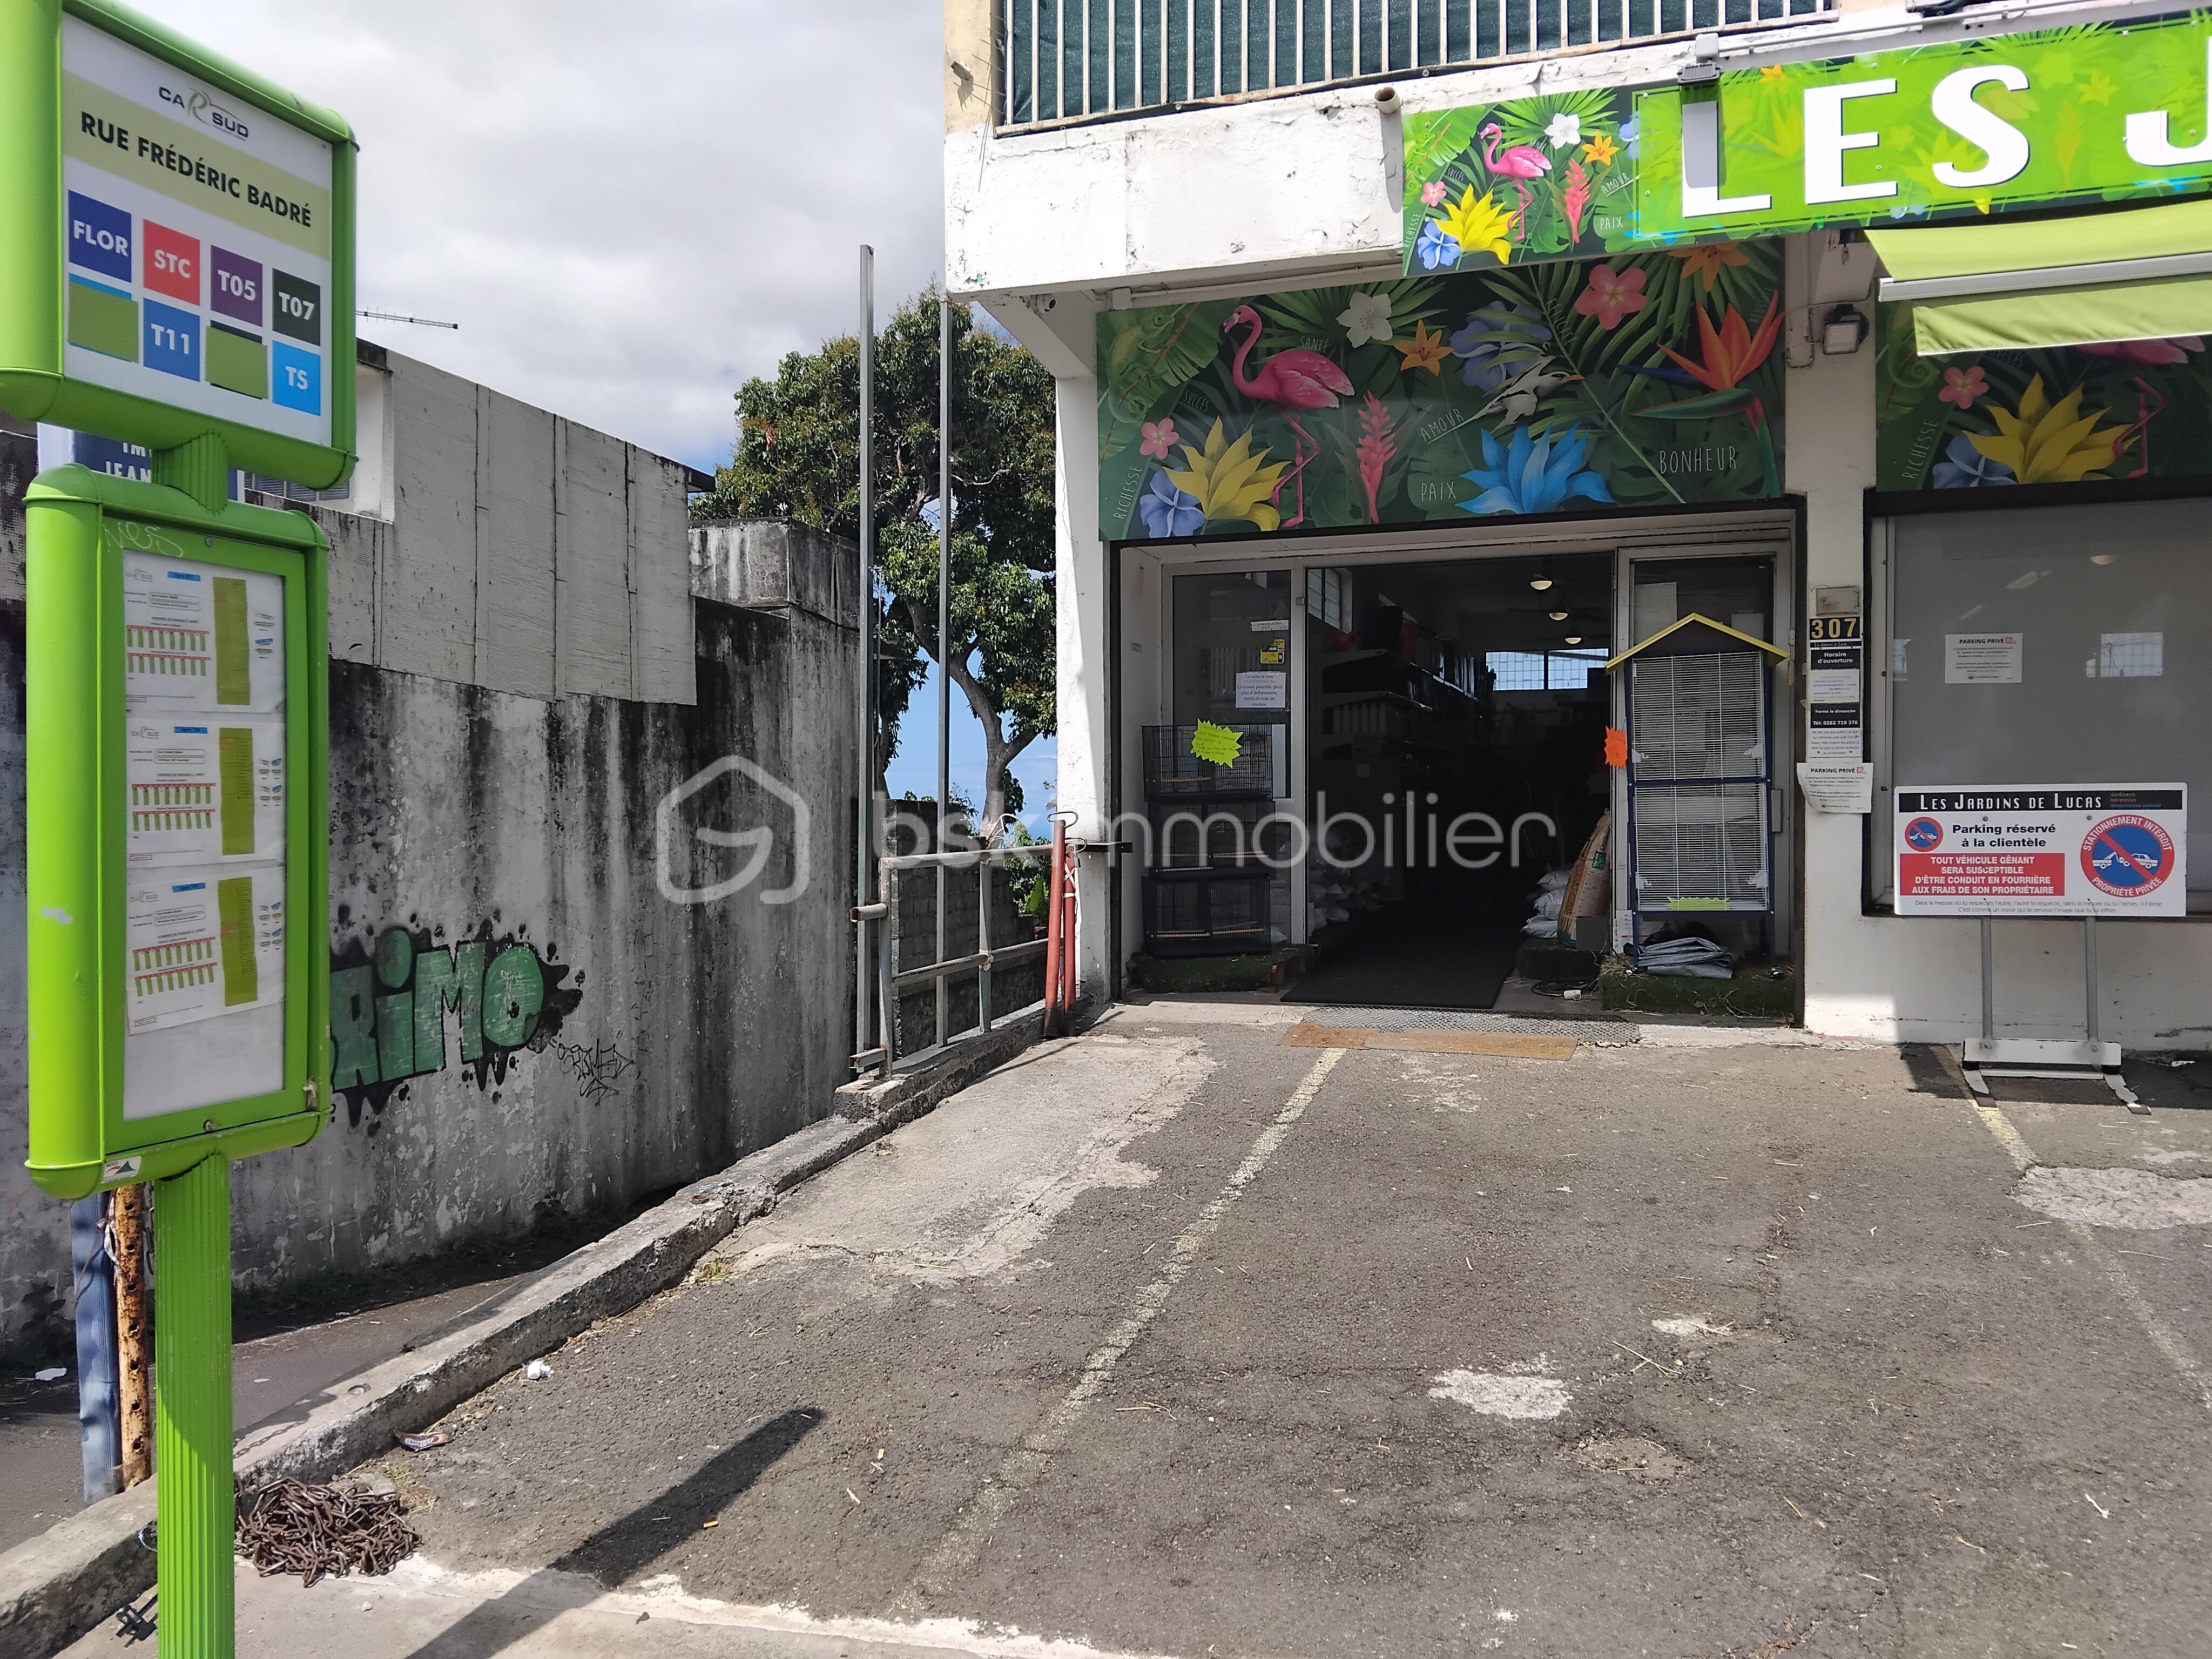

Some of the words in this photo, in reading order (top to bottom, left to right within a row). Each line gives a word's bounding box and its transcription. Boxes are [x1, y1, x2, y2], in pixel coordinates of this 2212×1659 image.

[212, 112, 249, 138] SUD
[1682, 64, 2031, 219] LES
[81, 111, 129, 151] RUE
[138, 136, 240, 198] FRÉDÉRIC
[247, 184, 311, 228] BADRÉ
[1447, 167, 1465, 182] SUCCÈS
[1602, 173, 1629, 194] AMOUR
[1403, 213, 1421, 248] RICHESSE
[1600, 216, 1623, 230] PAIX
[73, 220, 129, 257] FLOR
[154, 249, 191, 279] STC
[218, 269, 256, 301] T05
[278, 292, 315, 321] T07
[151, 323, 190, 354] T11
[1301, 336, 1330, 352] SANTÉ
[285, 366, 308, 390] TS
[1185, 389, 1210, 412] SUCCÈS
[1420, 407, 1464, 443] AMOUR
[1658, 445, 1737, 475] BONHEUR
[1901, 420, 1939, 480] RICHESSE
[1112, 466, 1143, 520] RICHESSE
[1421, 481, 1457, 501] PAIX
[1811, 618, 1857, 638] 307
[1920, 794, 1946, 810] LES
[1954, 794, 2020, 810] JARDINS
[2029, 797, 2045, 808] DE
[2054, 793, 2102, 808] LUCAS
[1952, 824, 2002, 835] Parking
[2007, 824, 2056, 834] réservé
[2082, 816, 2143, 851] STATIONNEMENT
[2144, 820, 2172, 851] INTERDIT
[1961, 838, 1969, 847] à
[1974, 838, 1985, 847] la
[1990, 838, 2046, 847] clientèle
[1956, 855, 1997, 864] VÉHICULE
[2000, 855, 2034, 864] GÊNANT
[1916, 874, 1945, 884] D'ÊTRE
[2002, 874, 2051, 884] FOURRIÈRE
[1993, 885, 2054, 894] PROPRIÉTAIRE
[2092, 876, 2134, 896] PROPRIÉTÉ
[2136, 876, 2162, 895] PRIVÉE
